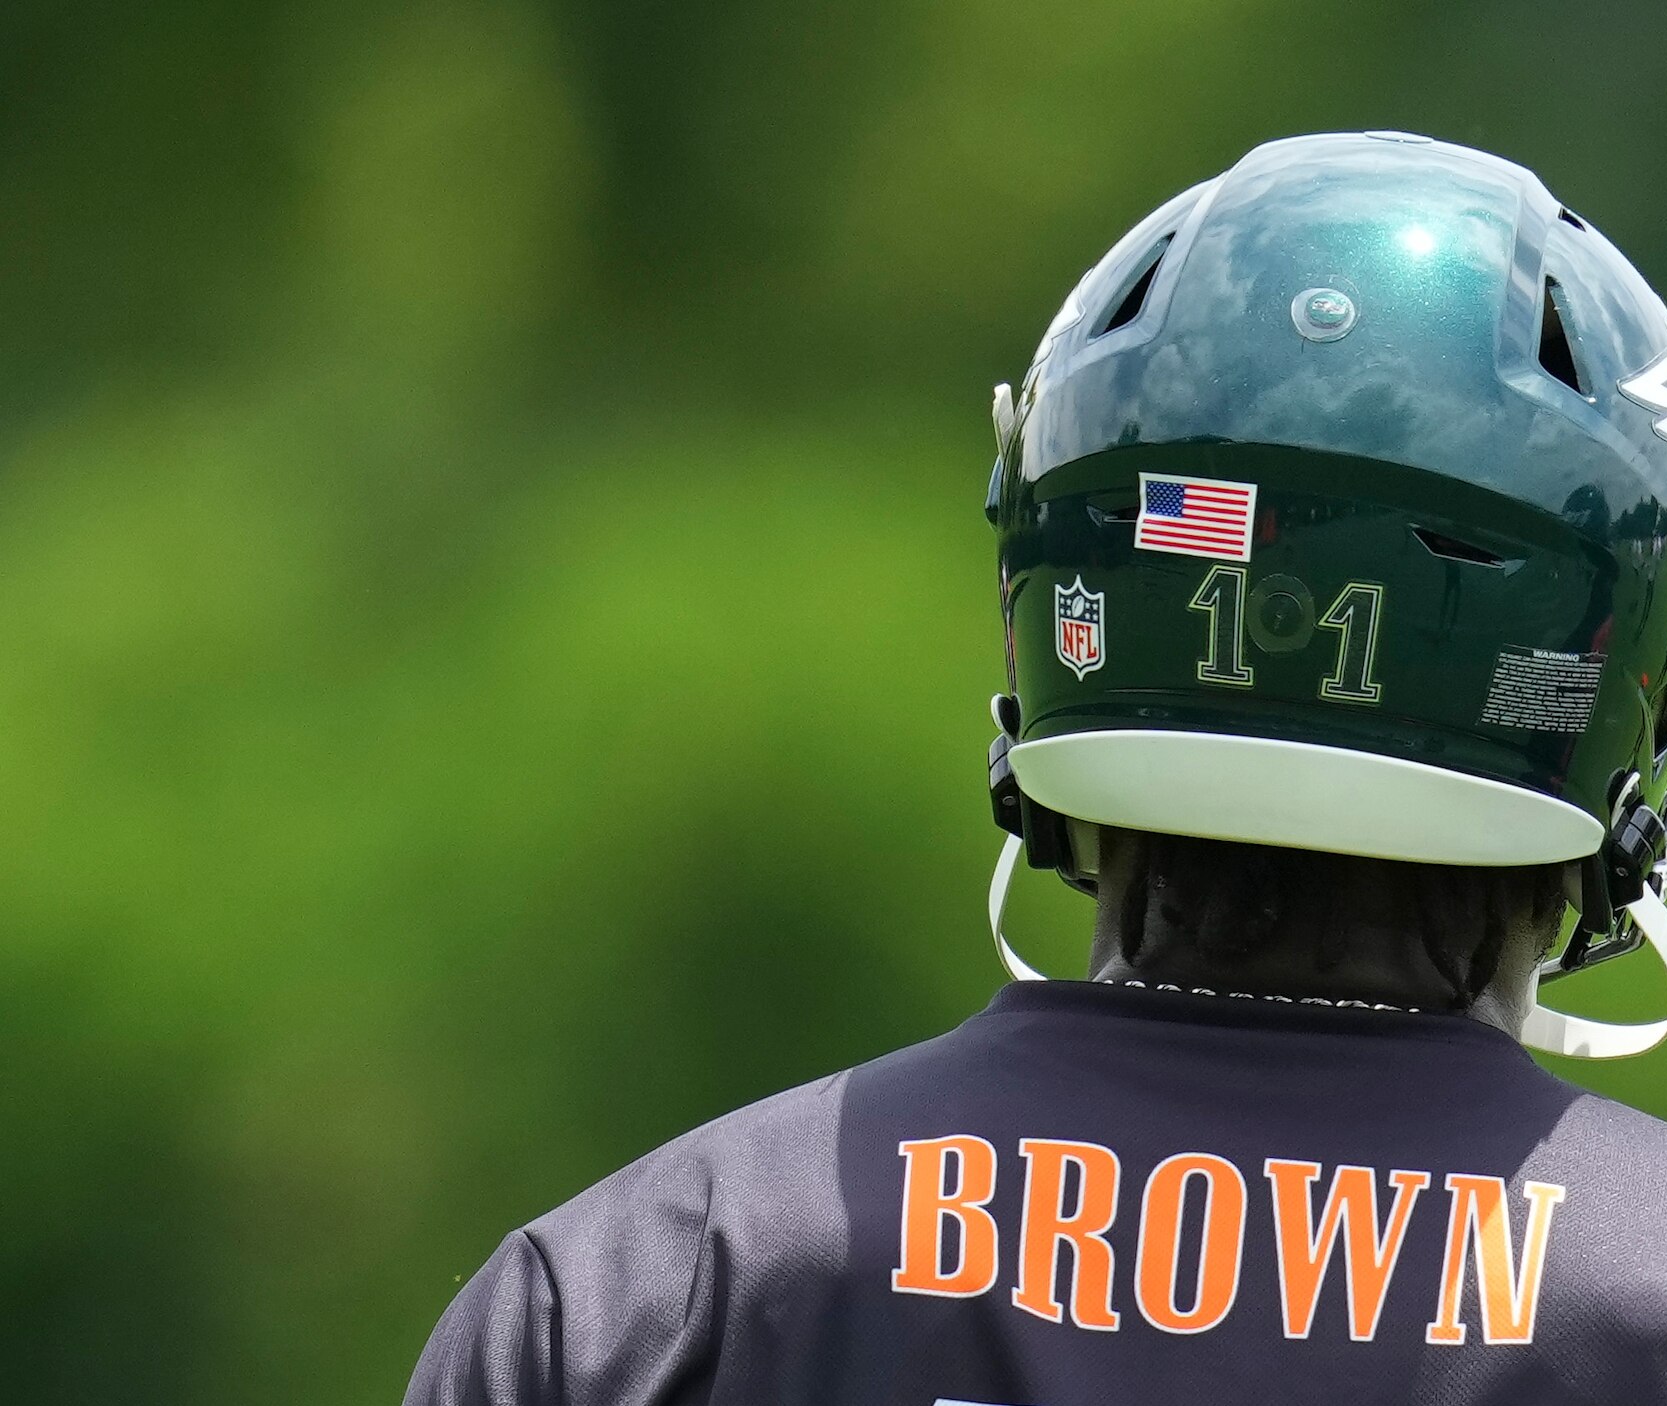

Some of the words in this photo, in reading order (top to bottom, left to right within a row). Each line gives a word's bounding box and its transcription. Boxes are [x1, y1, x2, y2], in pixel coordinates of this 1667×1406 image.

[1061, 620, 1098, 662] NFL
[1533, 649, 1580, 662] WARNING
[892, 1134, 1566, 1345] BROWN
